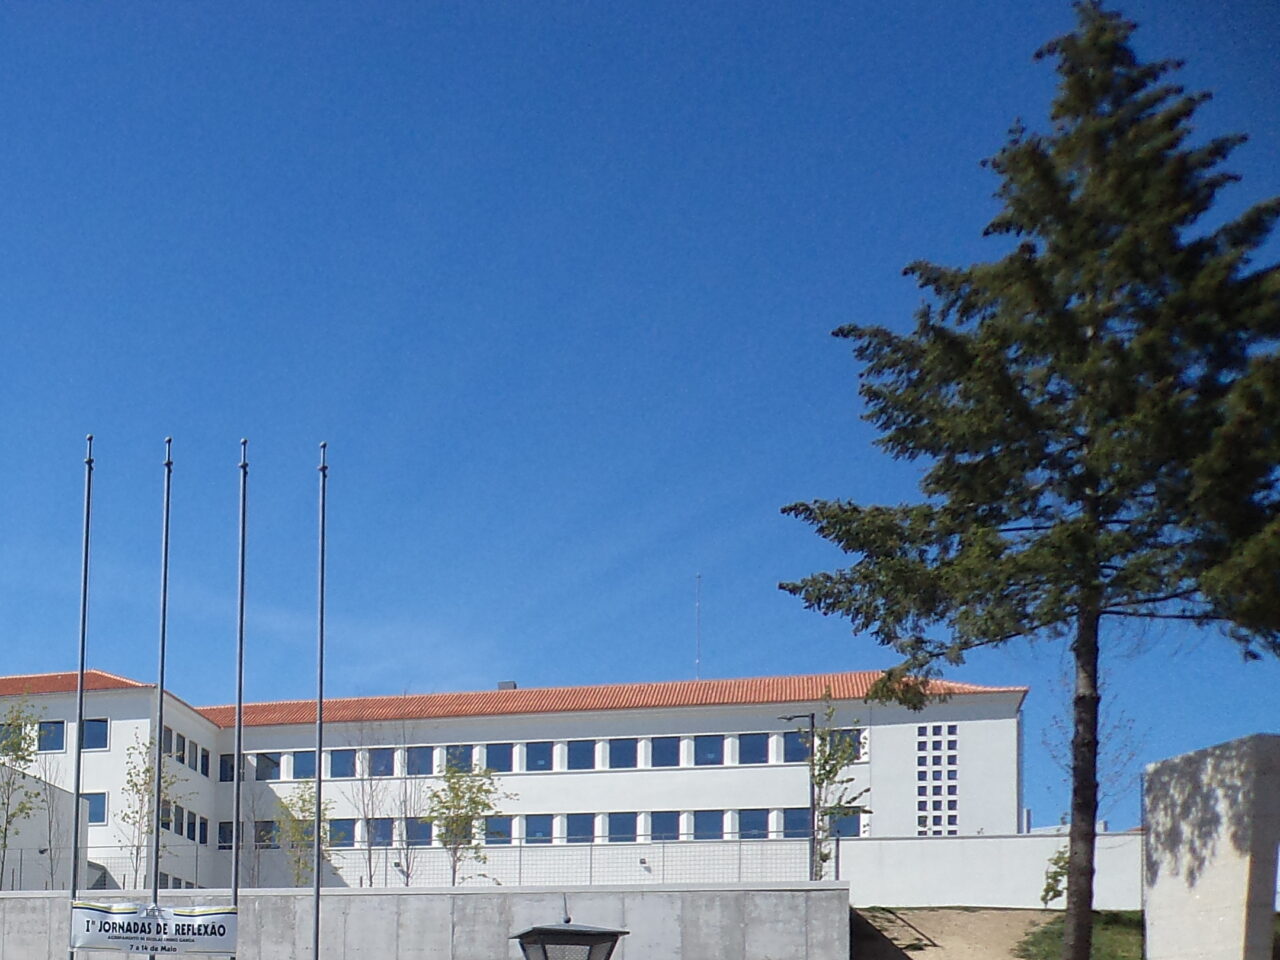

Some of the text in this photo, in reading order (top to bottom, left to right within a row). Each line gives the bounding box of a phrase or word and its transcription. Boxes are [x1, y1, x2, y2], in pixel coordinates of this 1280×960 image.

[98, 921, 152, 934] JORNADAS
[156, 923, 168, 935] DE
[174, 922, 226, 937] REFLEXÃO
